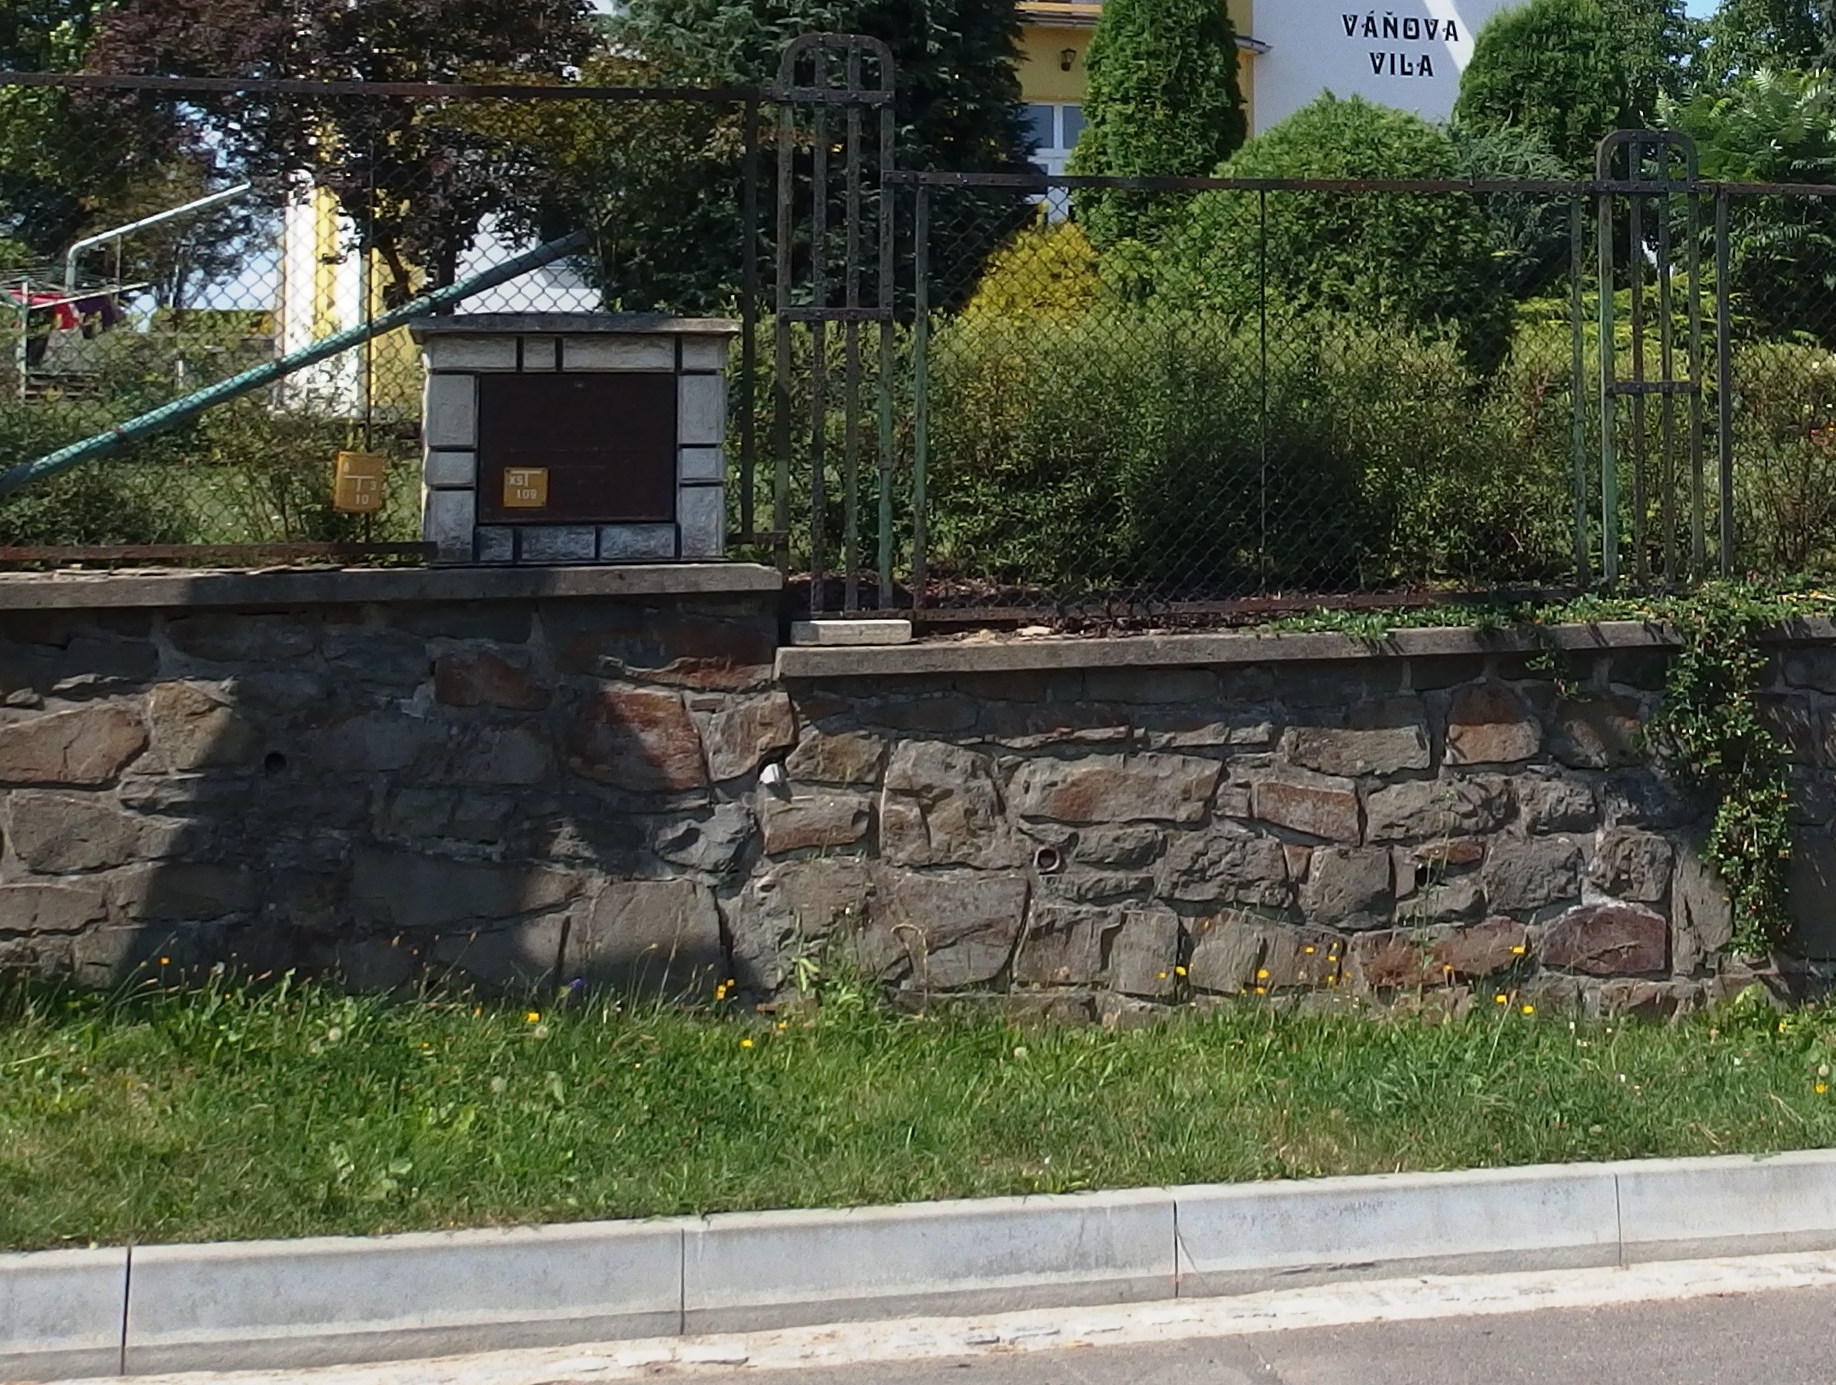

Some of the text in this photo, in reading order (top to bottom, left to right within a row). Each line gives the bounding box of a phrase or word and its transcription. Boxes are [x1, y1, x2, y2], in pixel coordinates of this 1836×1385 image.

[1342, 10, 1460, 42] VÁŇOVA
[1369, 52, 1435, 78] VILA
[355, 494, 369, 505] 10
